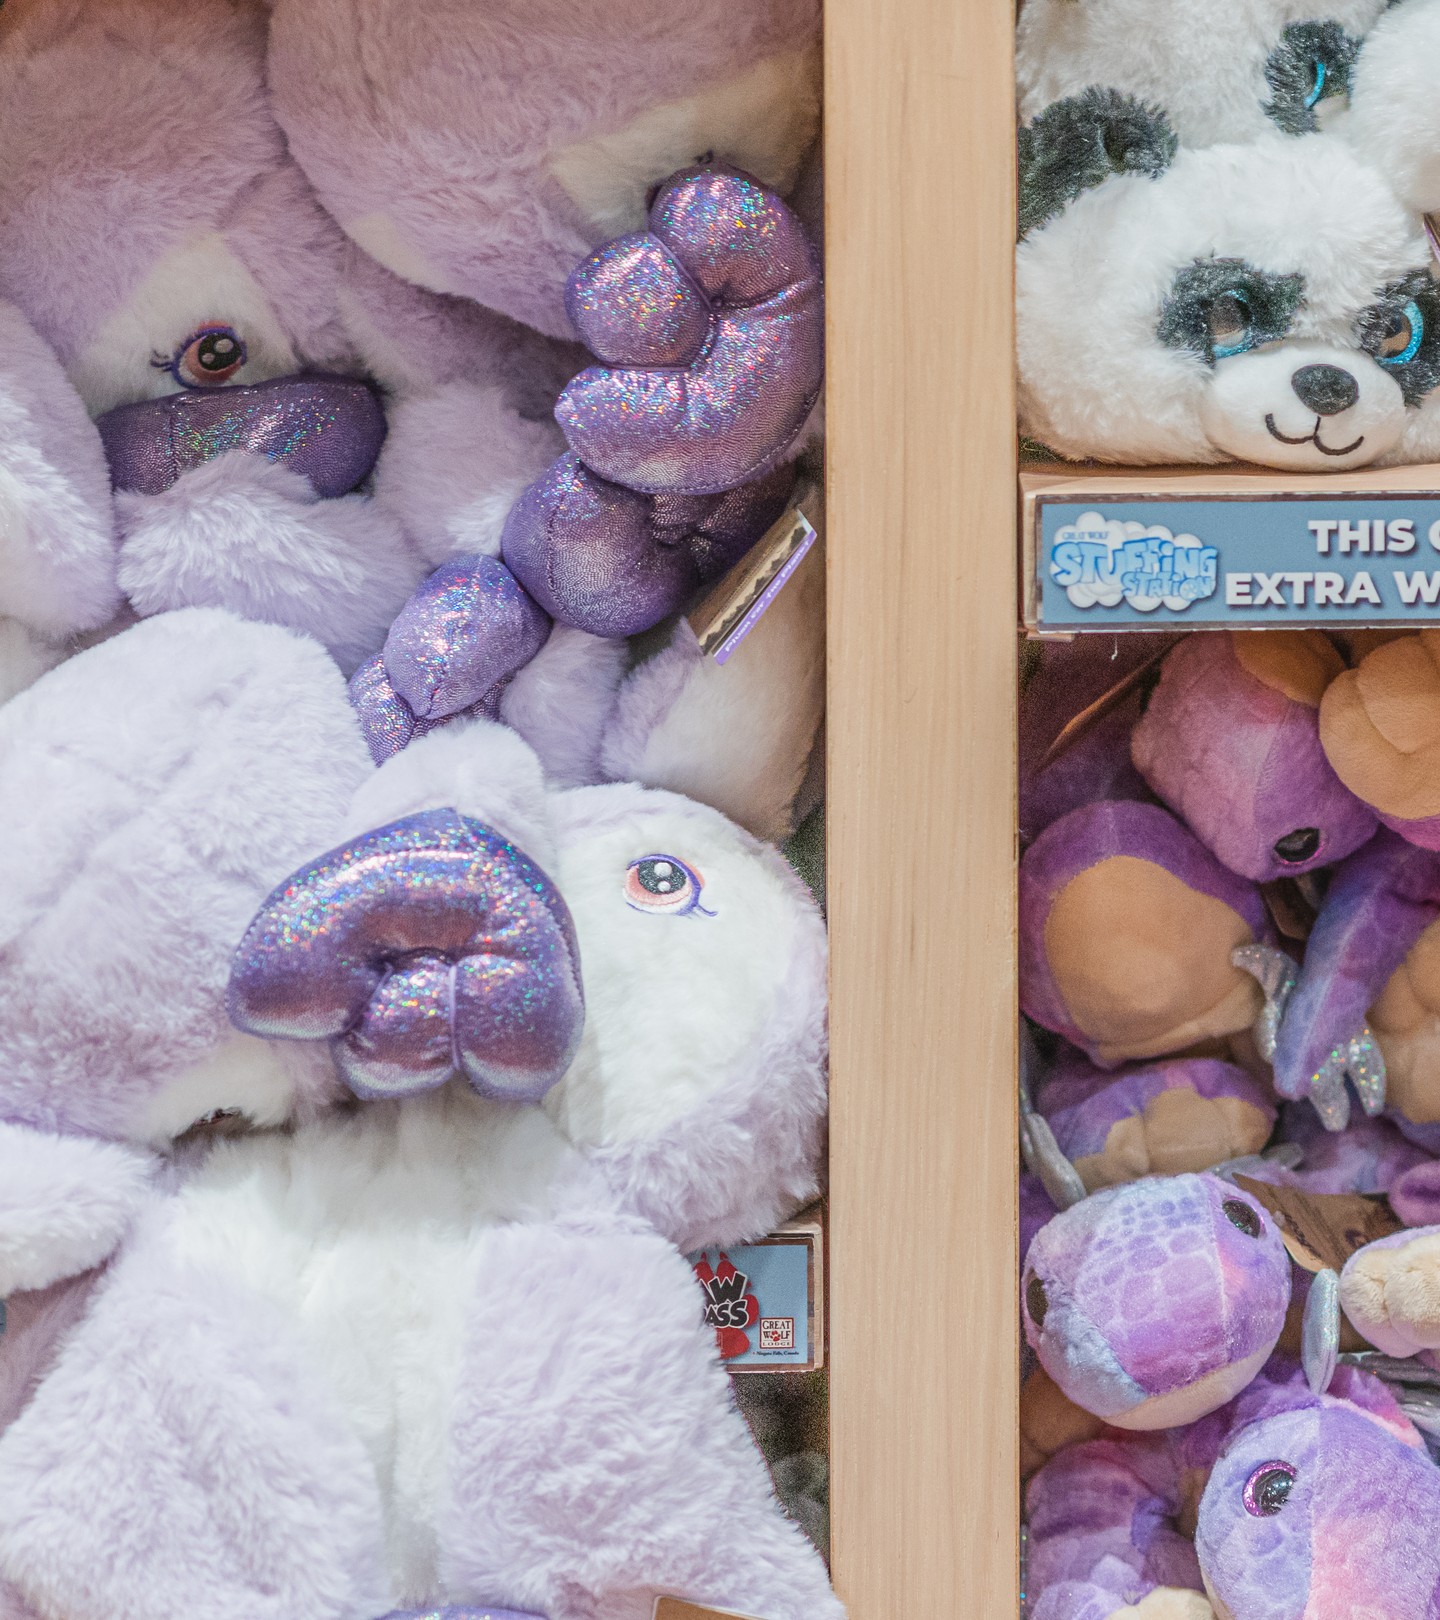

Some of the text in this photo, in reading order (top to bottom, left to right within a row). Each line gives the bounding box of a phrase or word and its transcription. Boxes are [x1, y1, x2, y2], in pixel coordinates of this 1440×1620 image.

[1308, 518, 1416, 553] THIS
[725, 621, 751, 652] Plush
[781, 540, 809, 578] Planet
[1225, 571, 1381, 605] EXTRA
[704, 1300, 748, 1328] ASS
[762, 1320, 792, 1330] GREAT
